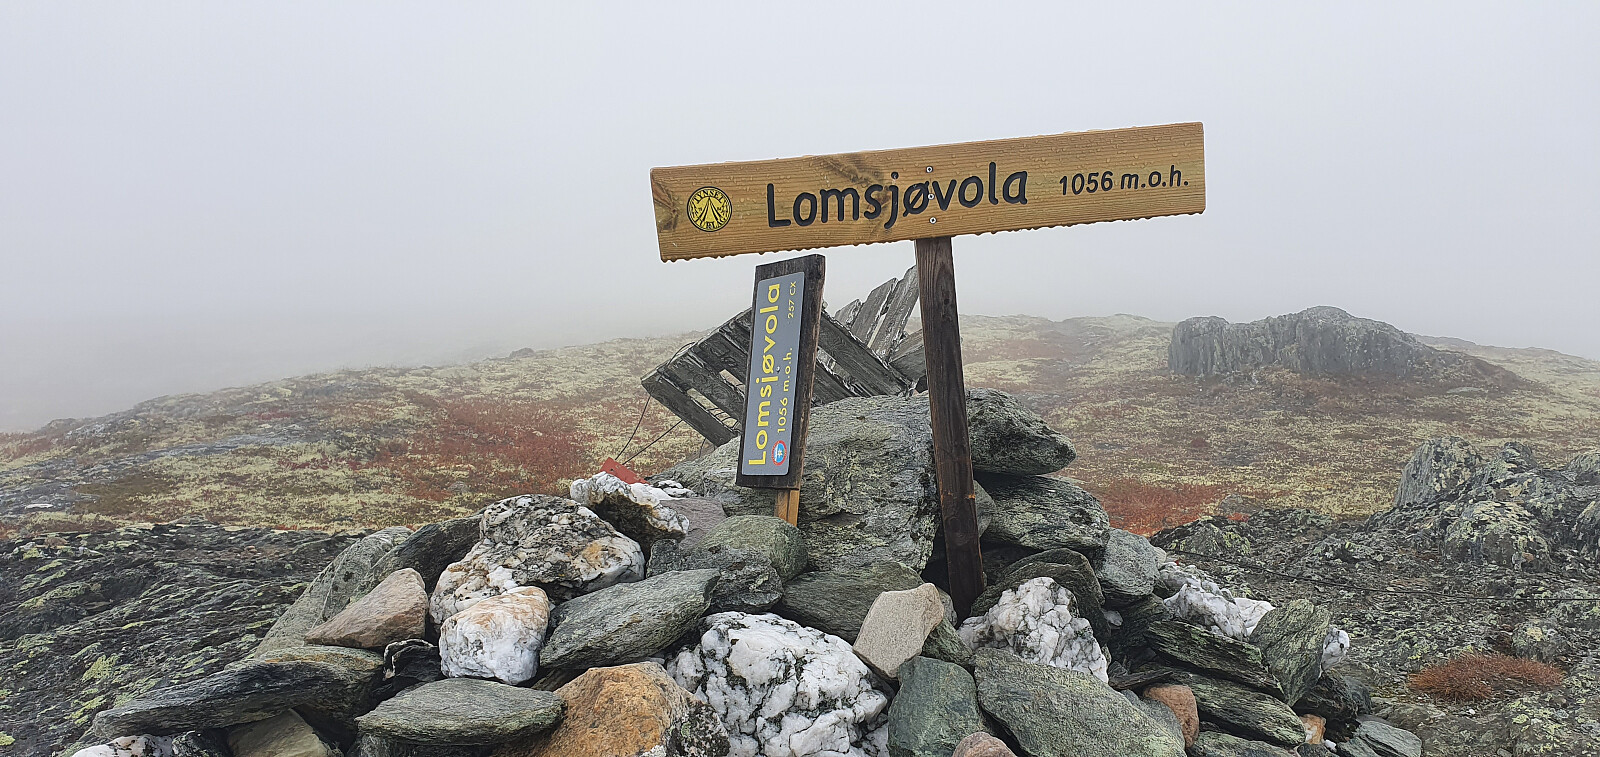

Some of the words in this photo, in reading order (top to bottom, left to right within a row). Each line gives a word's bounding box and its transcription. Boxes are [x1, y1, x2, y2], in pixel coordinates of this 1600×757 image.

[766, 161, 1029, 230] Lomsjøvola
[1059, 170, 1114, 197] 1056
[1120, 164, 1189, 191] m.o.h.
[789, 280, 797, 296] CX
[787, 299, 796, 319] 257
[748, 283, 781, 465] Lomsjøvola
[782, 347, 793, 392] m.o.h.
[777, 397, 789, 434] 1056
